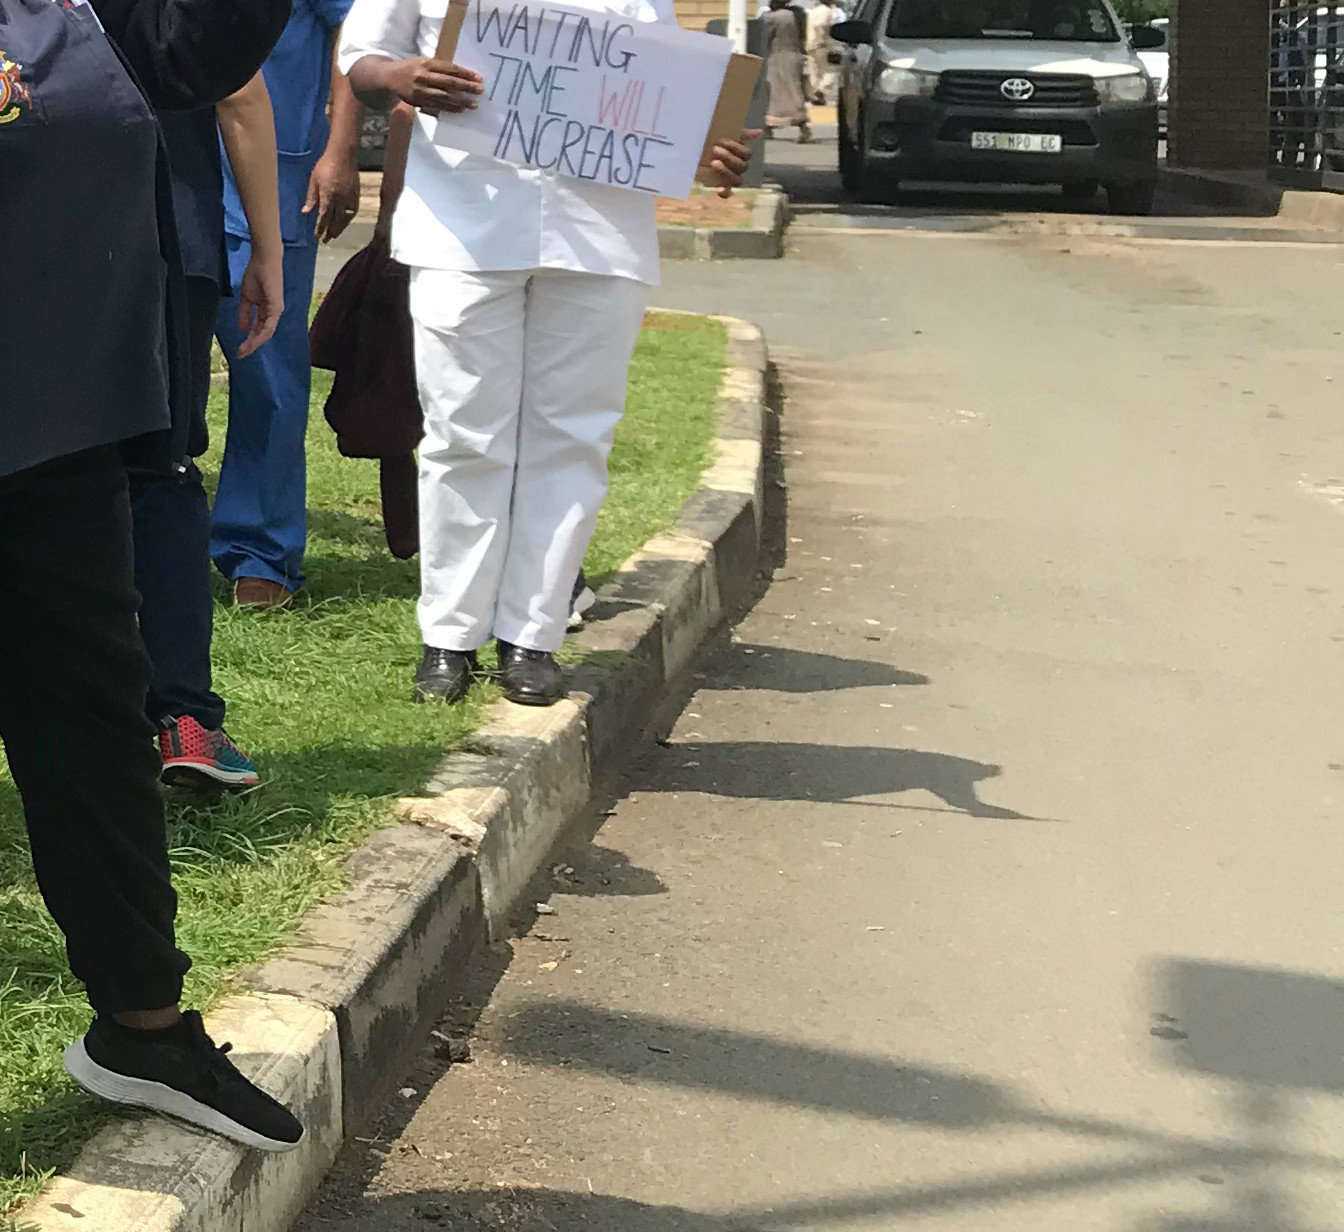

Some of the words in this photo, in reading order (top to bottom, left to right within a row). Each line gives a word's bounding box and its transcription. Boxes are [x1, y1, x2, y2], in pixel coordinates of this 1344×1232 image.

[488, 51, 579, 118] TIME
[597, 74, 668, 140] WILL
[493, 109, 675, 194] INCREASE
